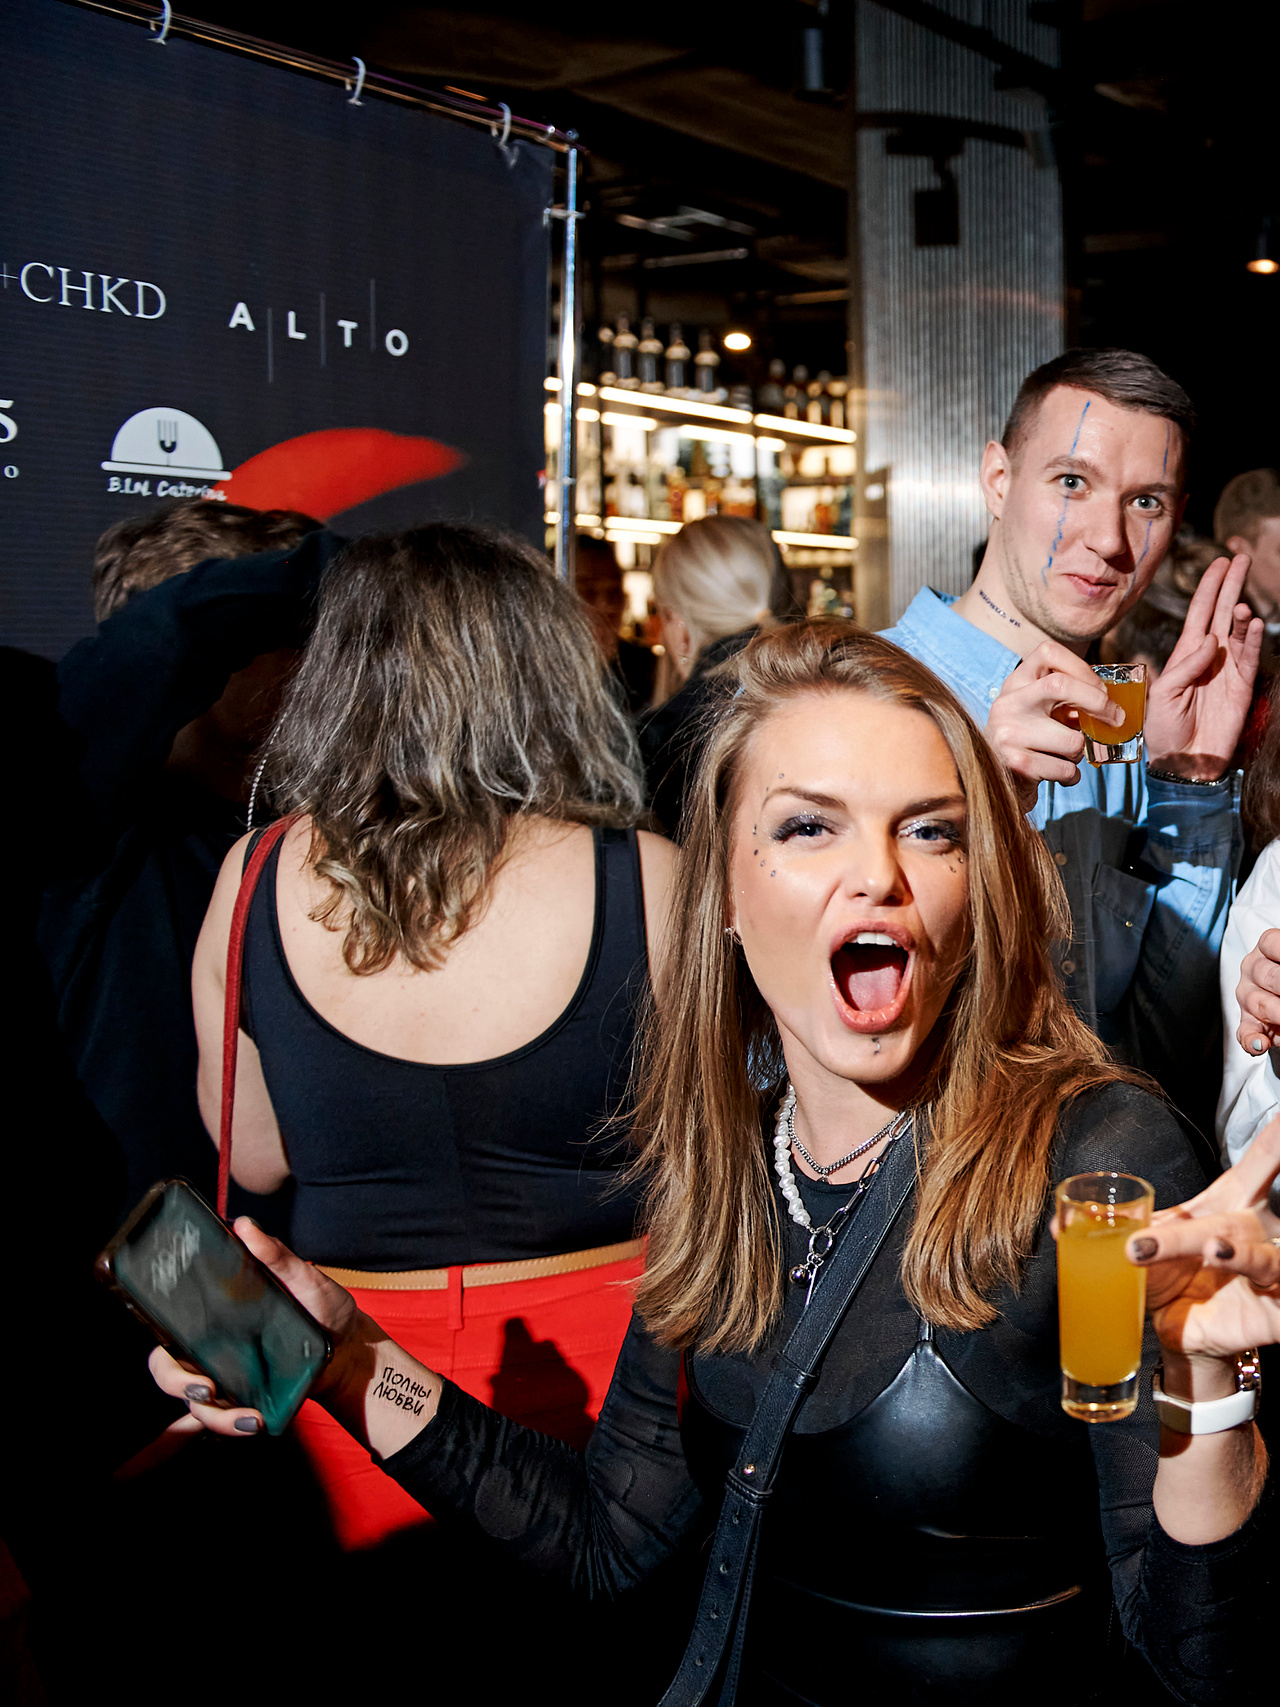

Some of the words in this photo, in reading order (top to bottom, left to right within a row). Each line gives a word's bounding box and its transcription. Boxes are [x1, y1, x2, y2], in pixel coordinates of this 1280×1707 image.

[20, 262, 167, 319] CHKD
[229, 302, 409, 356] ALTO
[373, 1381, 425, 1416] ЛЮБВИ
[382, 1366, 432, 1399] ПОЛНЫ
